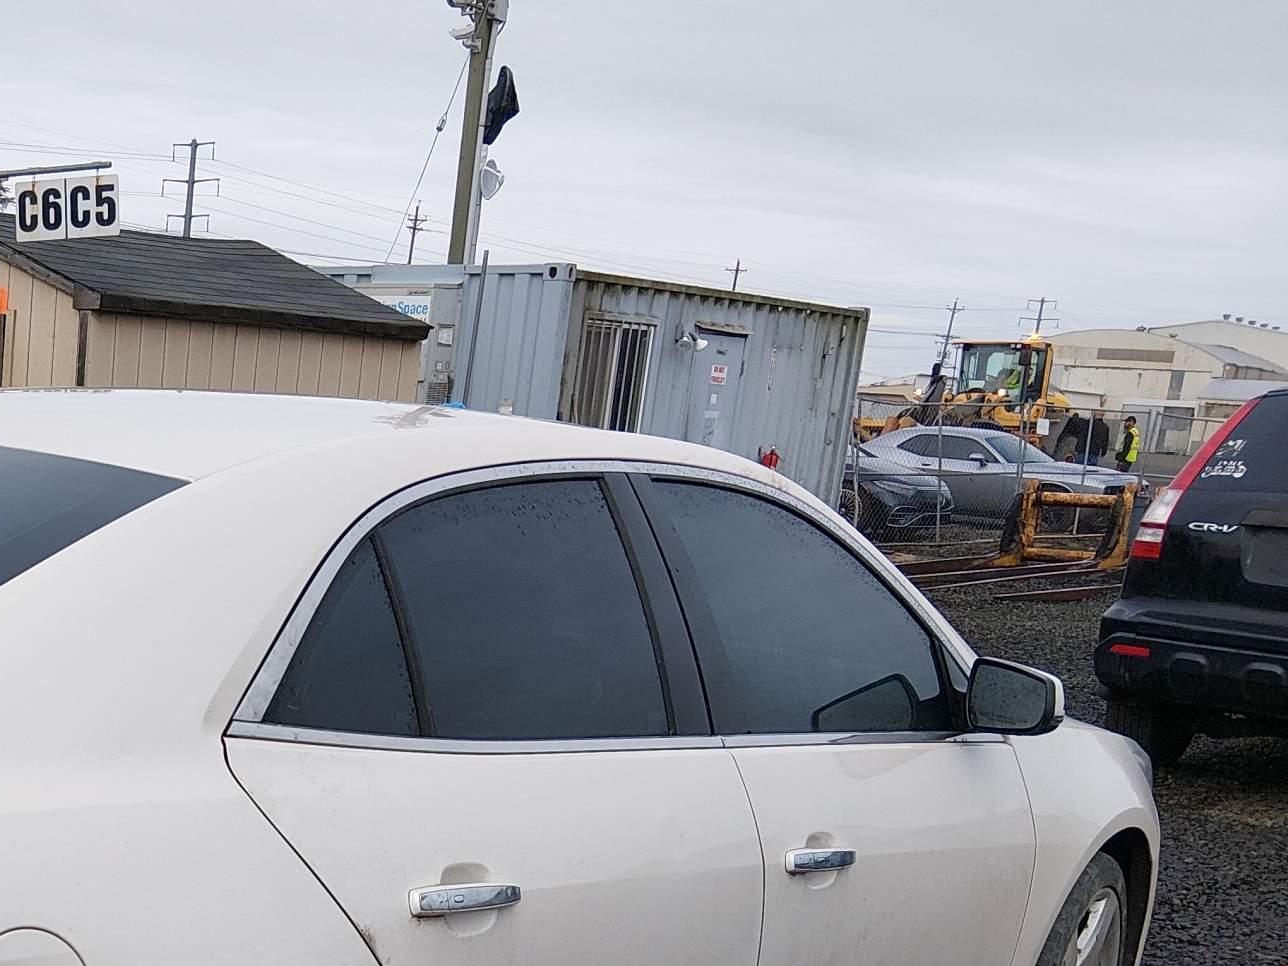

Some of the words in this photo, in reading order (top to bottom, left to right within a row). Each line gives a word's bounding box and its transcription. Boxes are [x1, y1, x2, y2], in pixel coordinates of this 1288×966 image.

[18, 188, 62, 232] C6
[70, 184, 116, 229] C5
[1188, 522, 1240, 533] CR-V
